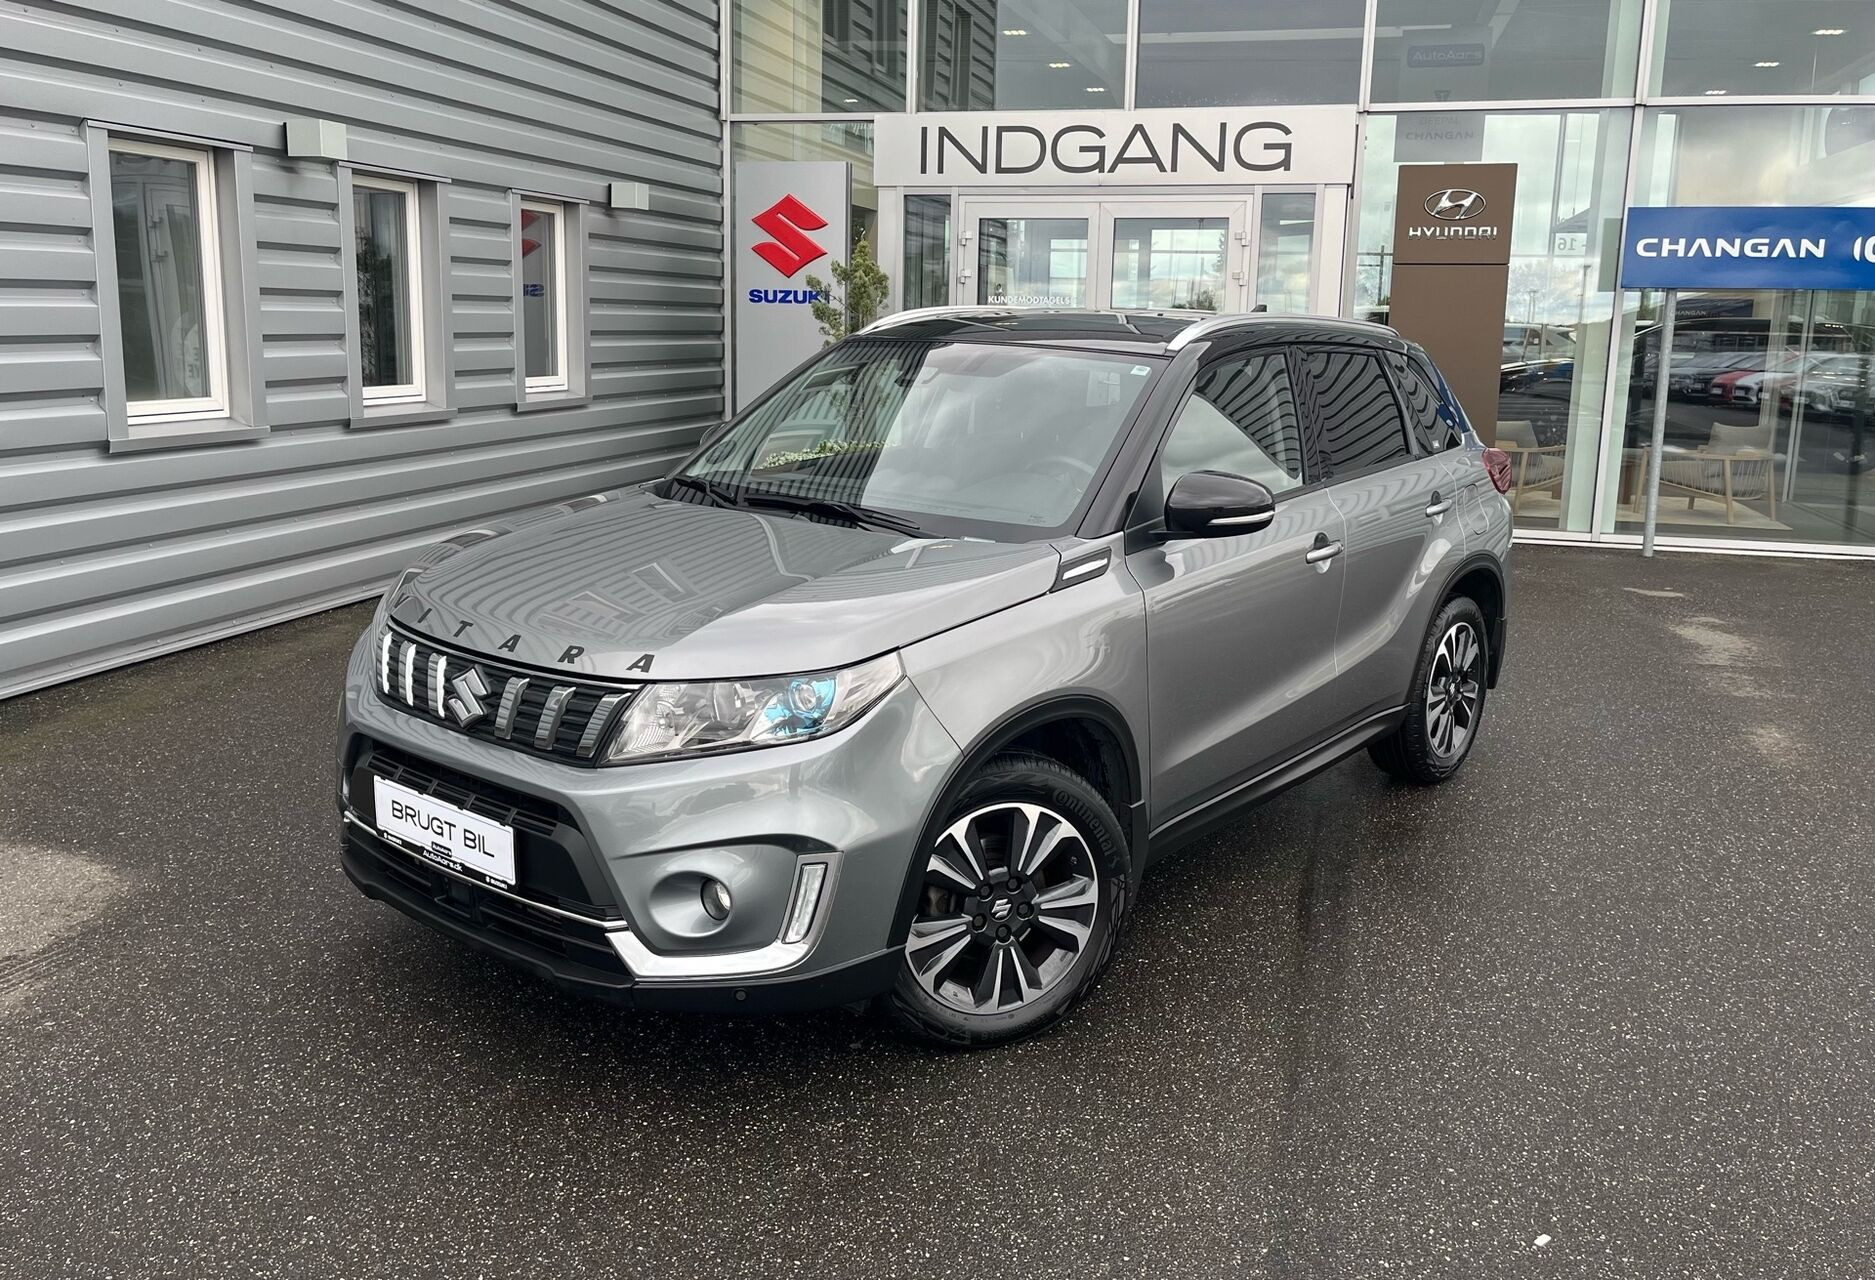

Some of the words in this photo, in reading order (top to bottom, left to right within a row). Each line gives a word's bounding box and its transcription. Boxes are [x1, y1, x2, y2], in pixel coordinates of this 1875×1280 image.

[1406, 130, 1474, 140] CHANGAN
[920, 121, 1293, 175] INDGANG
[1408, 226, 1498, 240] HYUNDAI
[1636, 237, 1826, 259] CHANGAN
[391, 799, 457, 841] BRUGT
[463, 828, 495, 858] BIL
